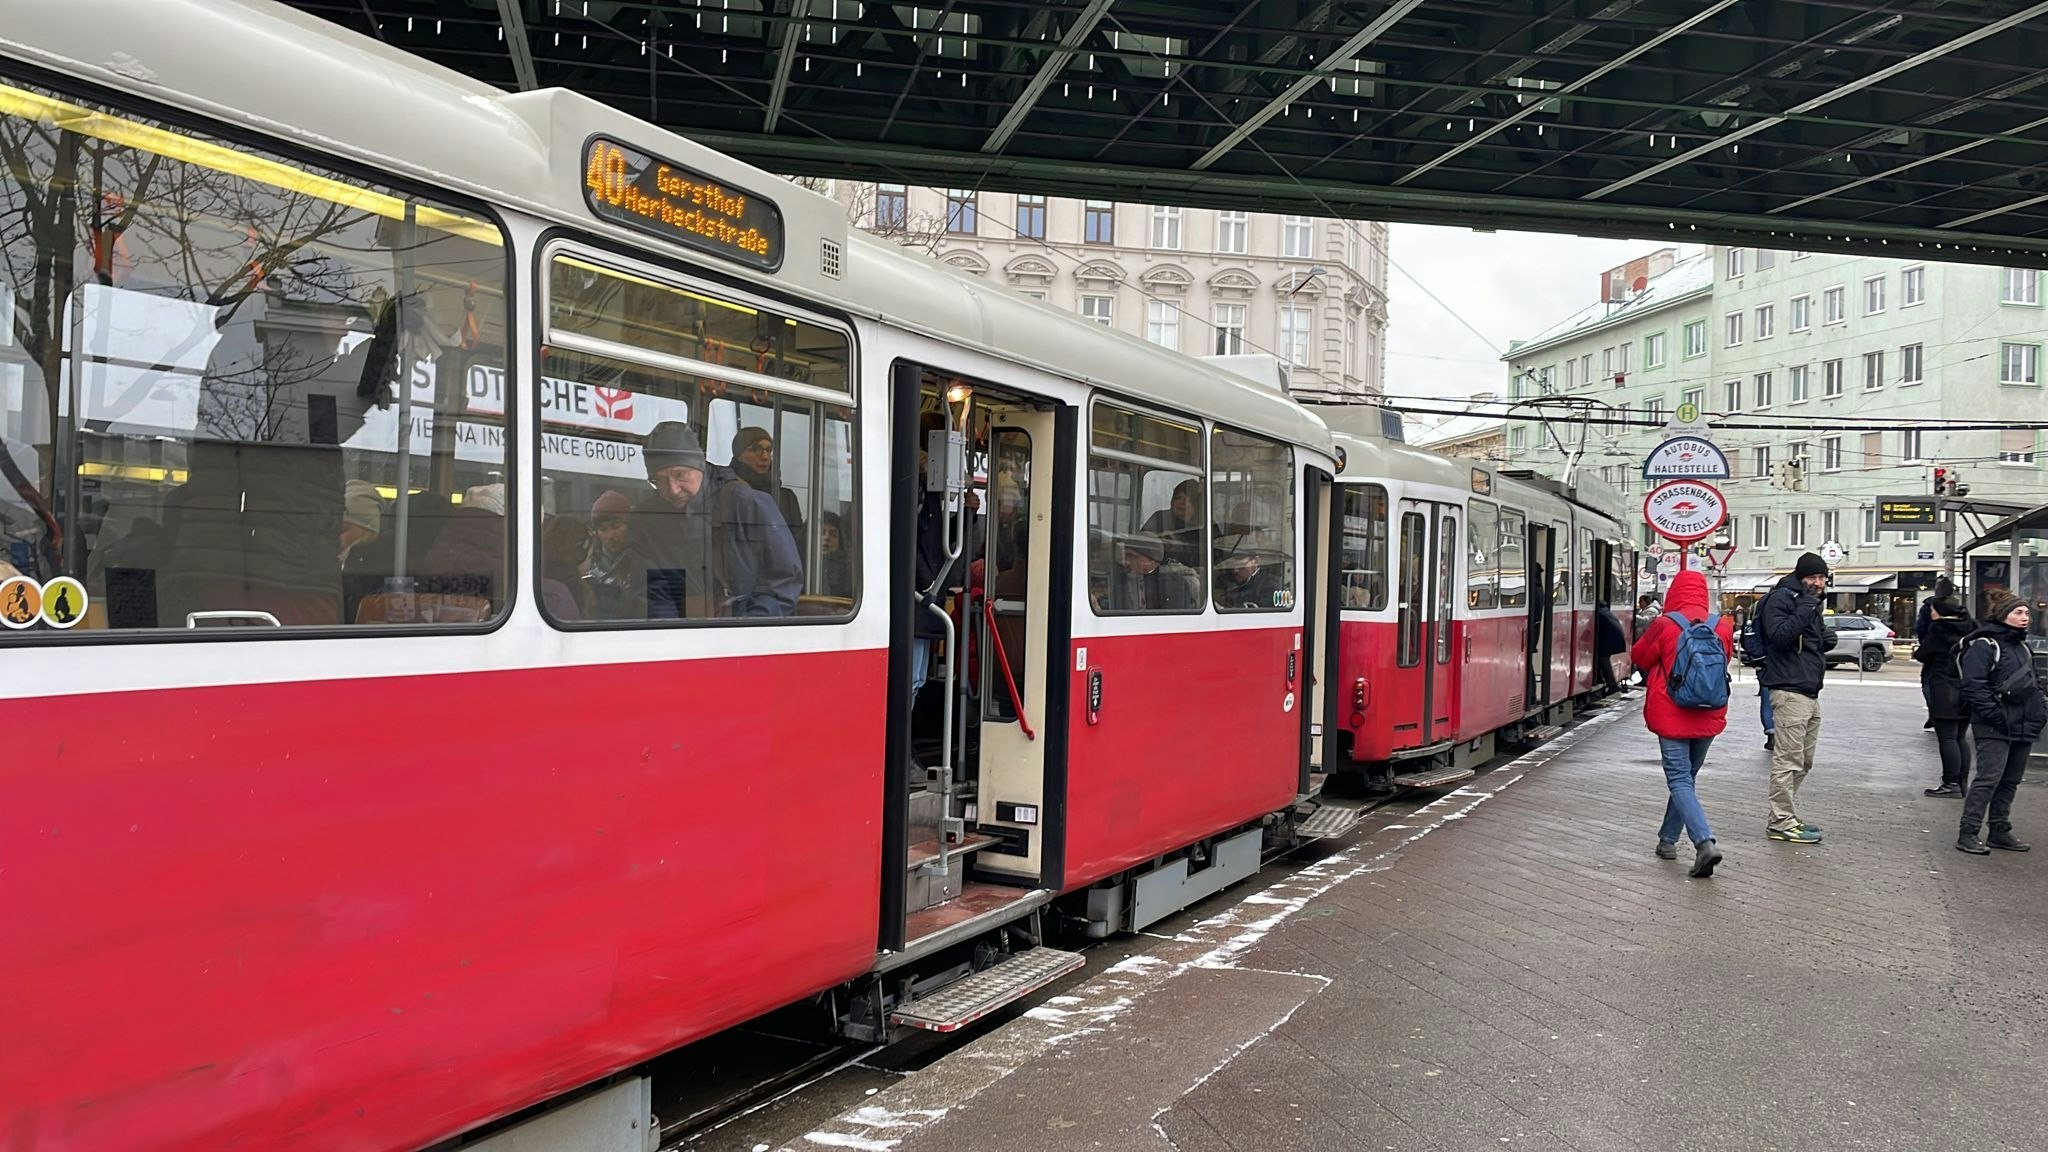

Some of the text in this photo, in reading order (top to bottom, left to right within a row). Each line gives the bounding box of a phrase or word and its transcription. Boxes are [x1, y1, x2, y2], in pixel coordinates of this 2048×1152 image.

[587, 143, 624, 205] 40
[657, 165, 745, 219] Gersthof
[624, 185, 769, 255] Herbeckstraße
[1682, 407, 1693, 420] H
[584, 441, 636, 463] GROUP
[1664, 443, 1711, 458] AUTOBUS
[1654, 464, 1719, 474] HALTESTELLE
[1653, 486, 1718, 509] STRASSENBAHN
[1655, 515, 1714, 533] HALTESTELLE
